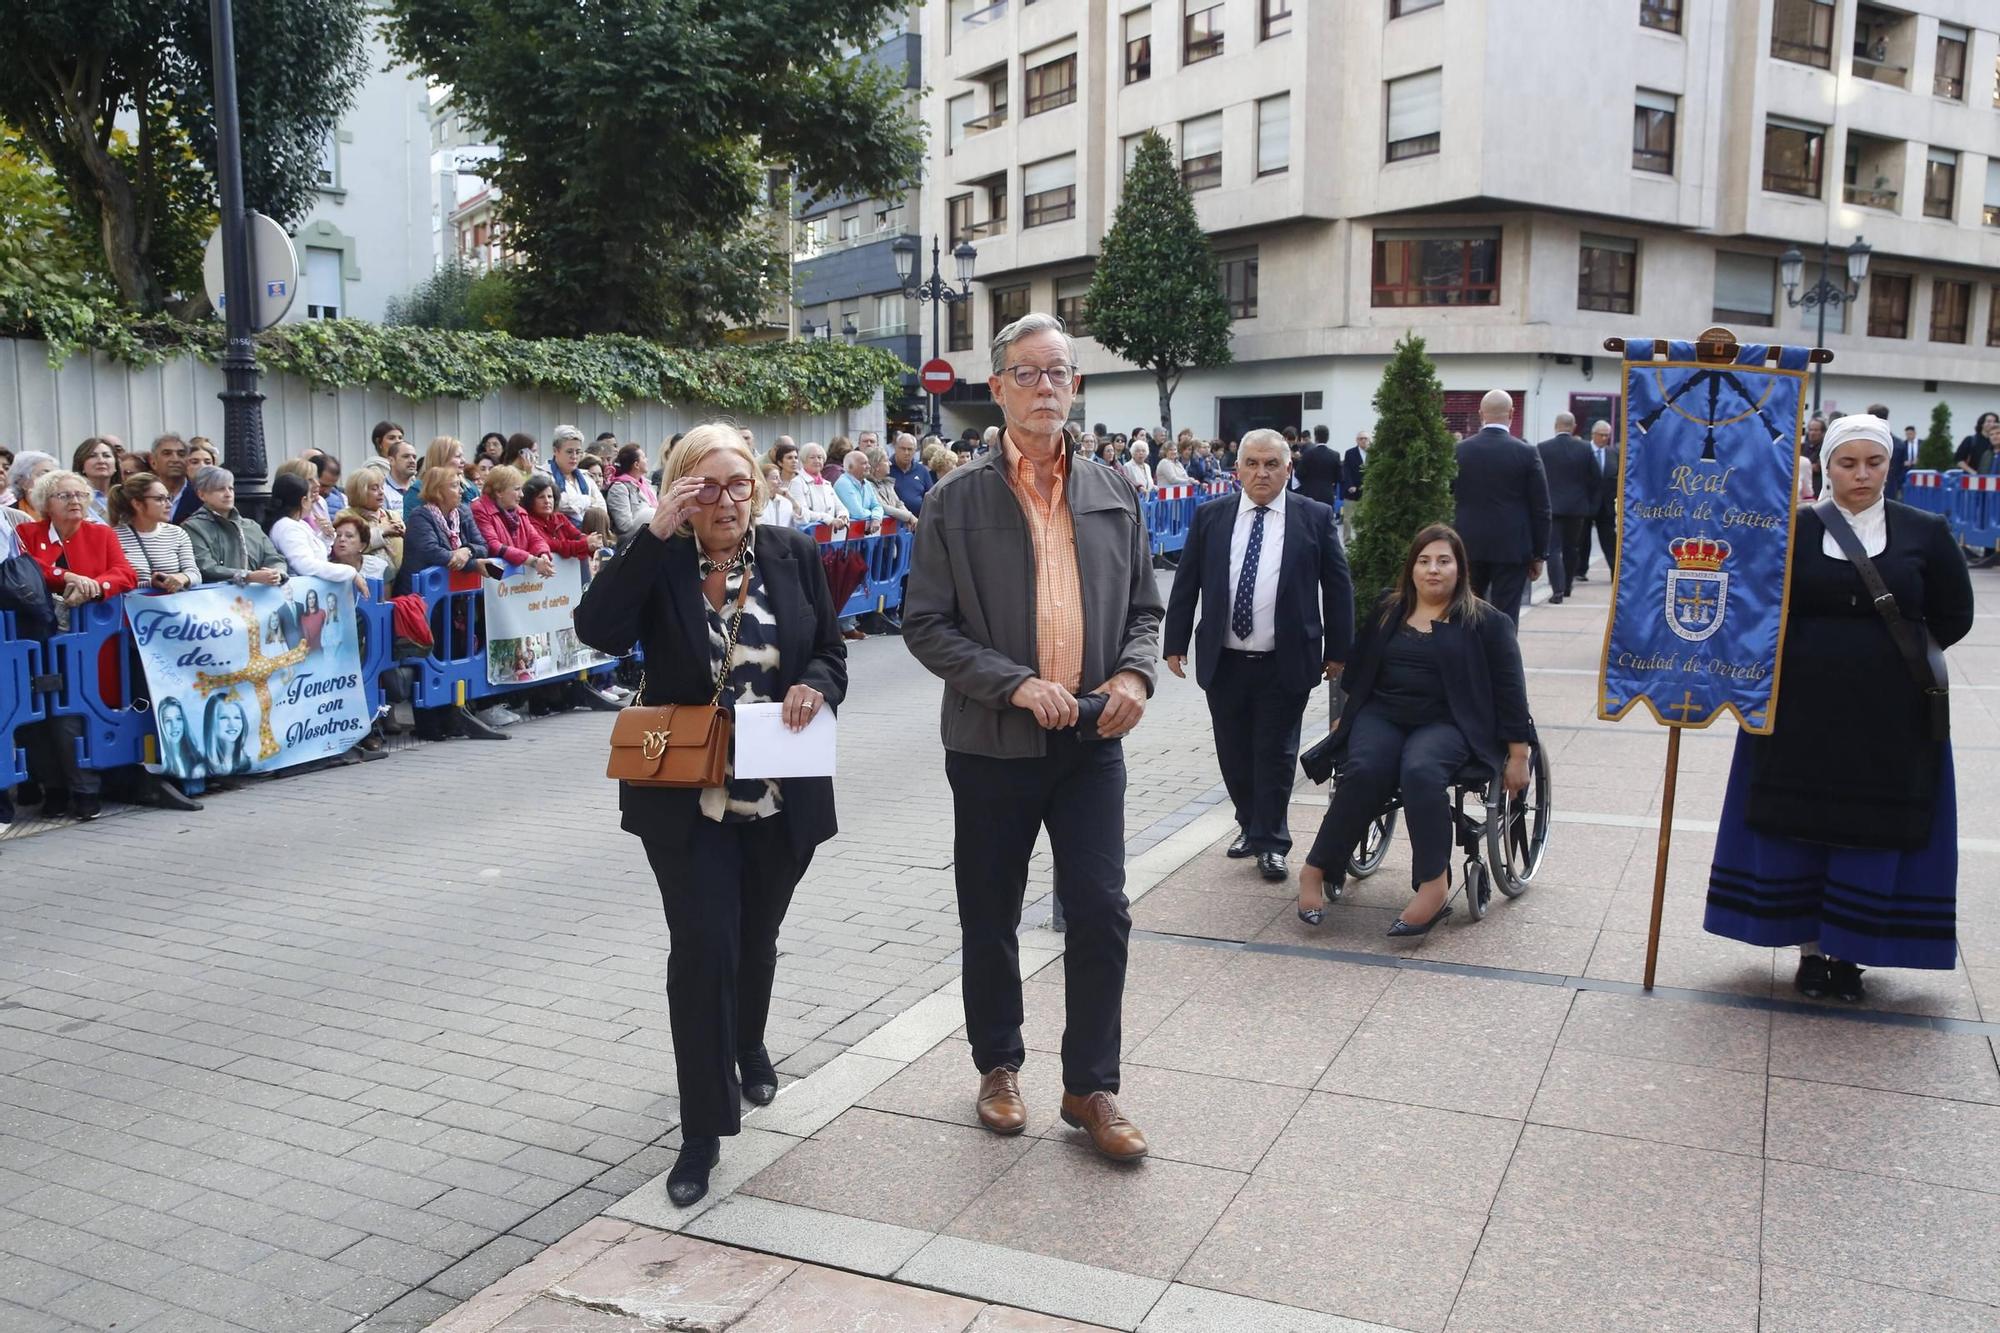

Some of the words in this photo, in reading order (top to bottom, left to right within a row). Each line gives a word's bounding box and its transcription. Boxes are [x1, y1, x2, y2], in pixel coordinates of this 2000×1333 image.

[1668, 464, 1736, 496] Real
[1693, 501, 1712, 521] de
[1723, 505, 1782, 529] Gaitas
[542, 596, 548, 609] el
[134, 609, 233, 646] Felices
[177, 647, 231, 667] de...
[1618, 651, 1679, 671] Ciudad
[1683, 654, 1701, 673] de
[318, 698, 344, 715] con
[286, 717, 363, 748] Nosotros.
